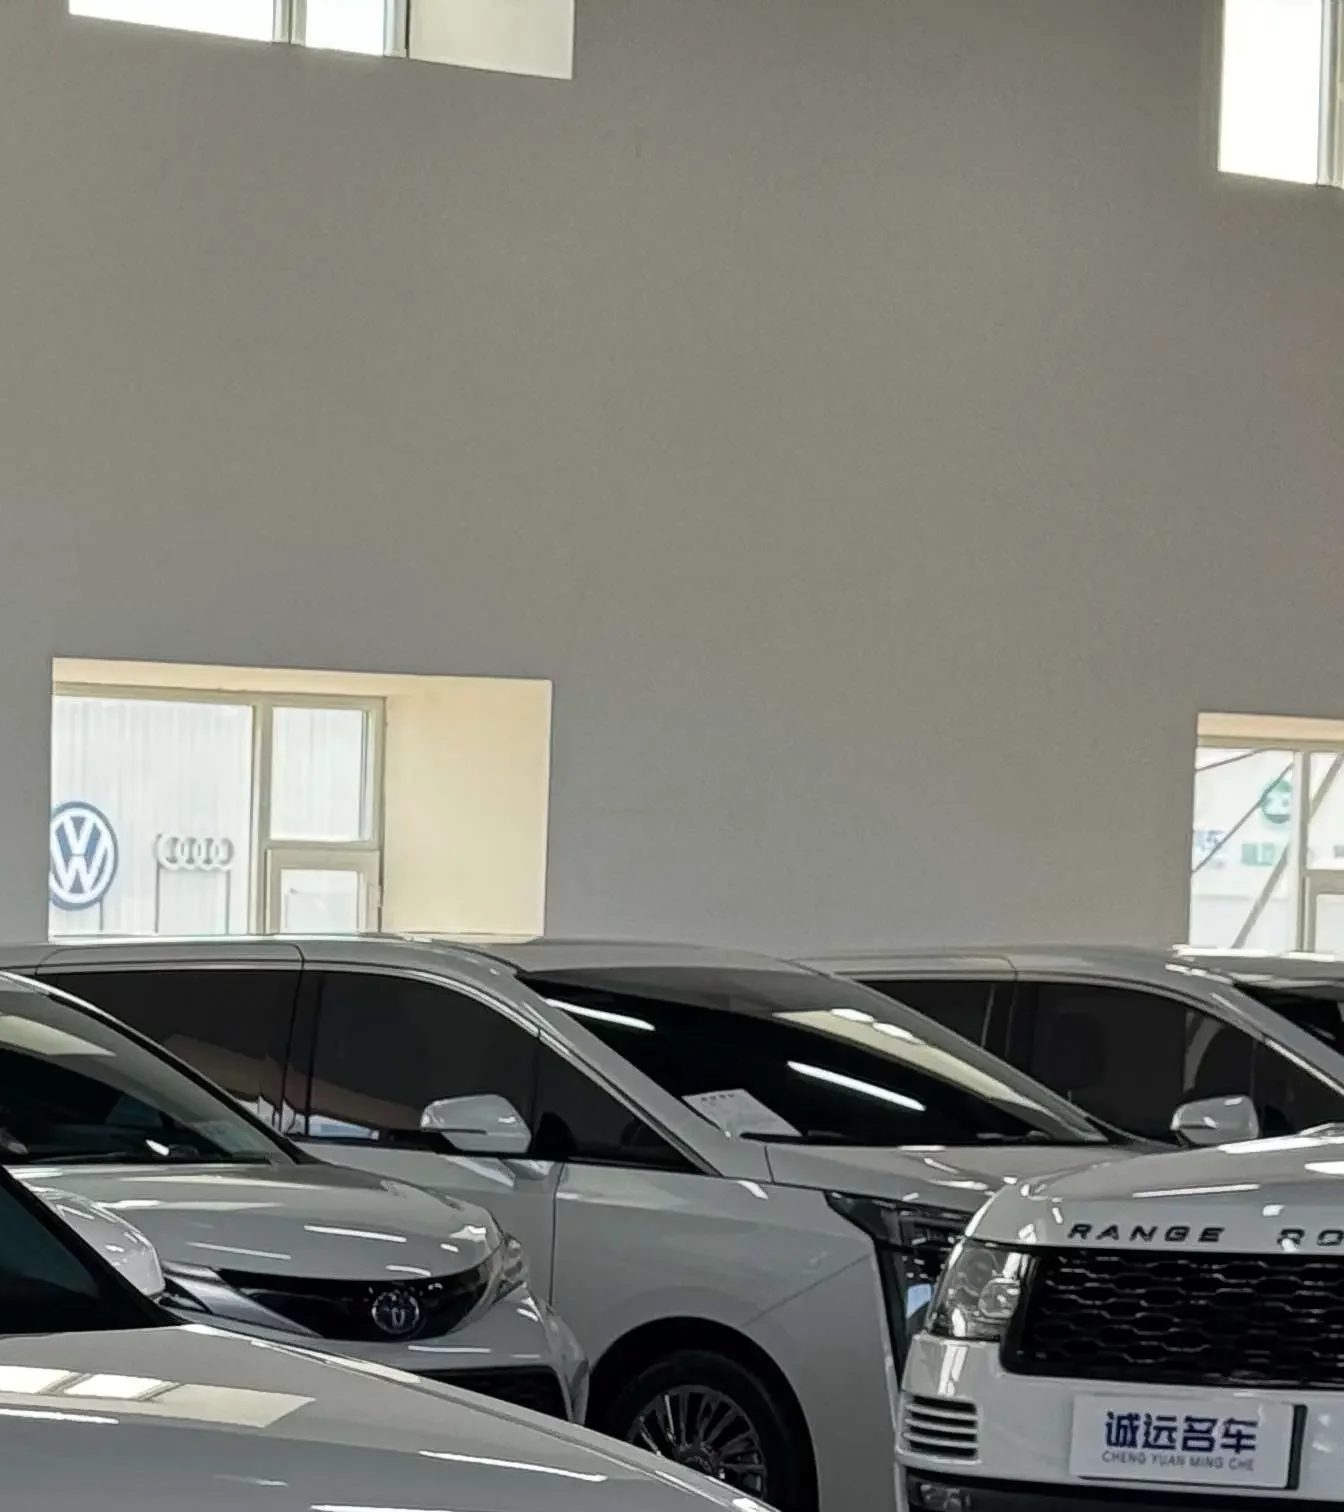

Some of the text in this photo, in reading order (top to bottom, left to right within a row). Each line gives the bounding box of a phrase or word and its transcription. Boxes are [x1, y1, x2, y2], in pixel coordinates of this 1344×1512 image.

[1067, 1222, 1226, 1244] RANGE
[1104, 1411, 1259, 1454] 诚远名车
[1101, 1450, 1255, 1472] CHENG YUAN MING CHE
